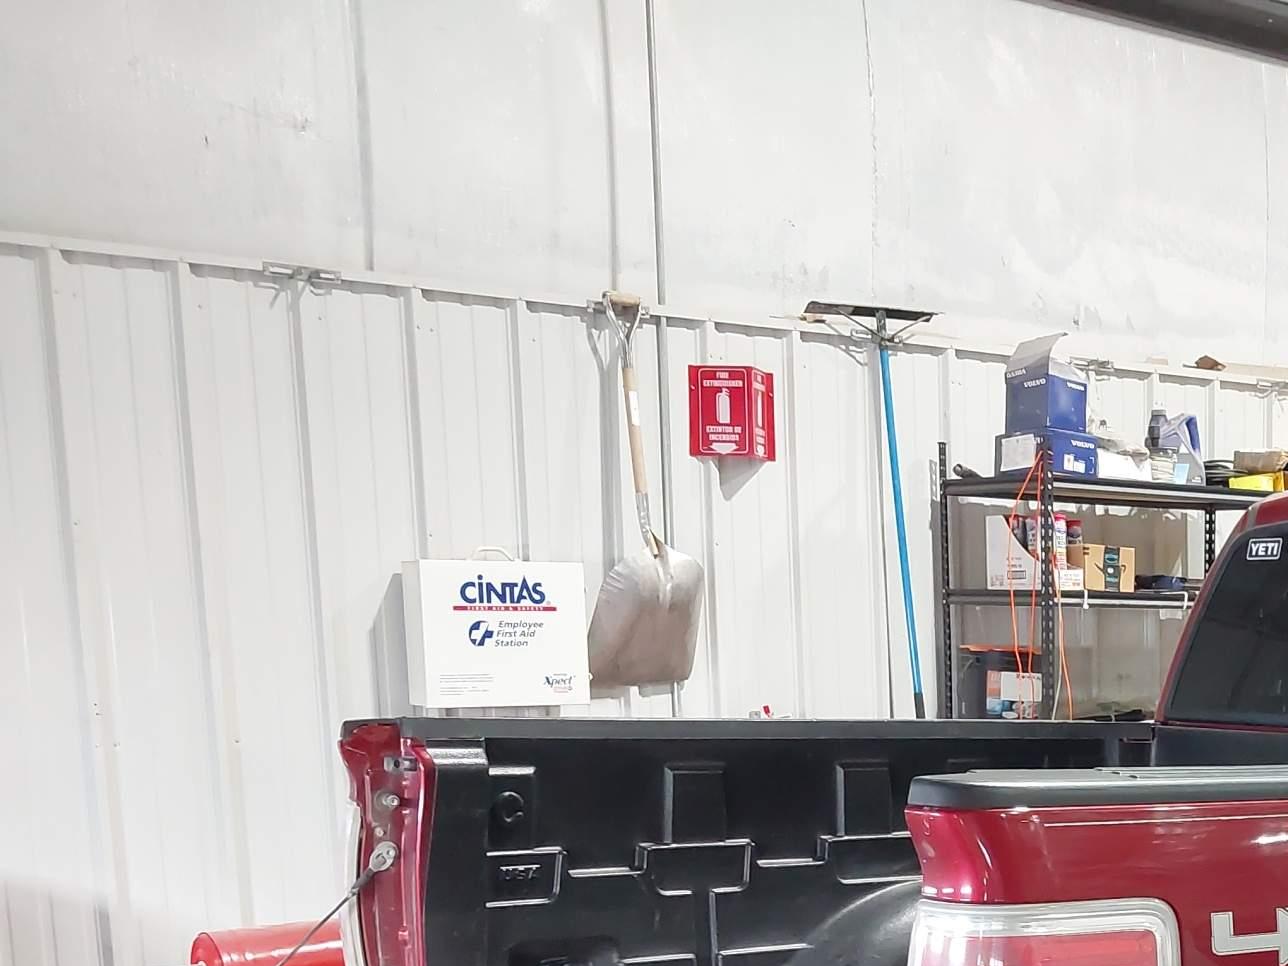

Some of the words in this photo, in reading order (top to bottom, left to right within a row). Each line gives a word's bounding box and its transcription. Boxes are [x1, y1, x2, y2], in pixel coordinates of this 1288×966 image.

[1024, 378, 1046, 388] VOLVO
[1071, 439, 1095, 449] VOLVO
[1251, 542, 1279, 556] YETI
[460, 574, 546, 604] CINTAS
[498, 620, 544, 630] Employee
[496, 630, 518, 638] First
[519, 629, 536, 638] Aid
[494, 639, 529, 647] Station
